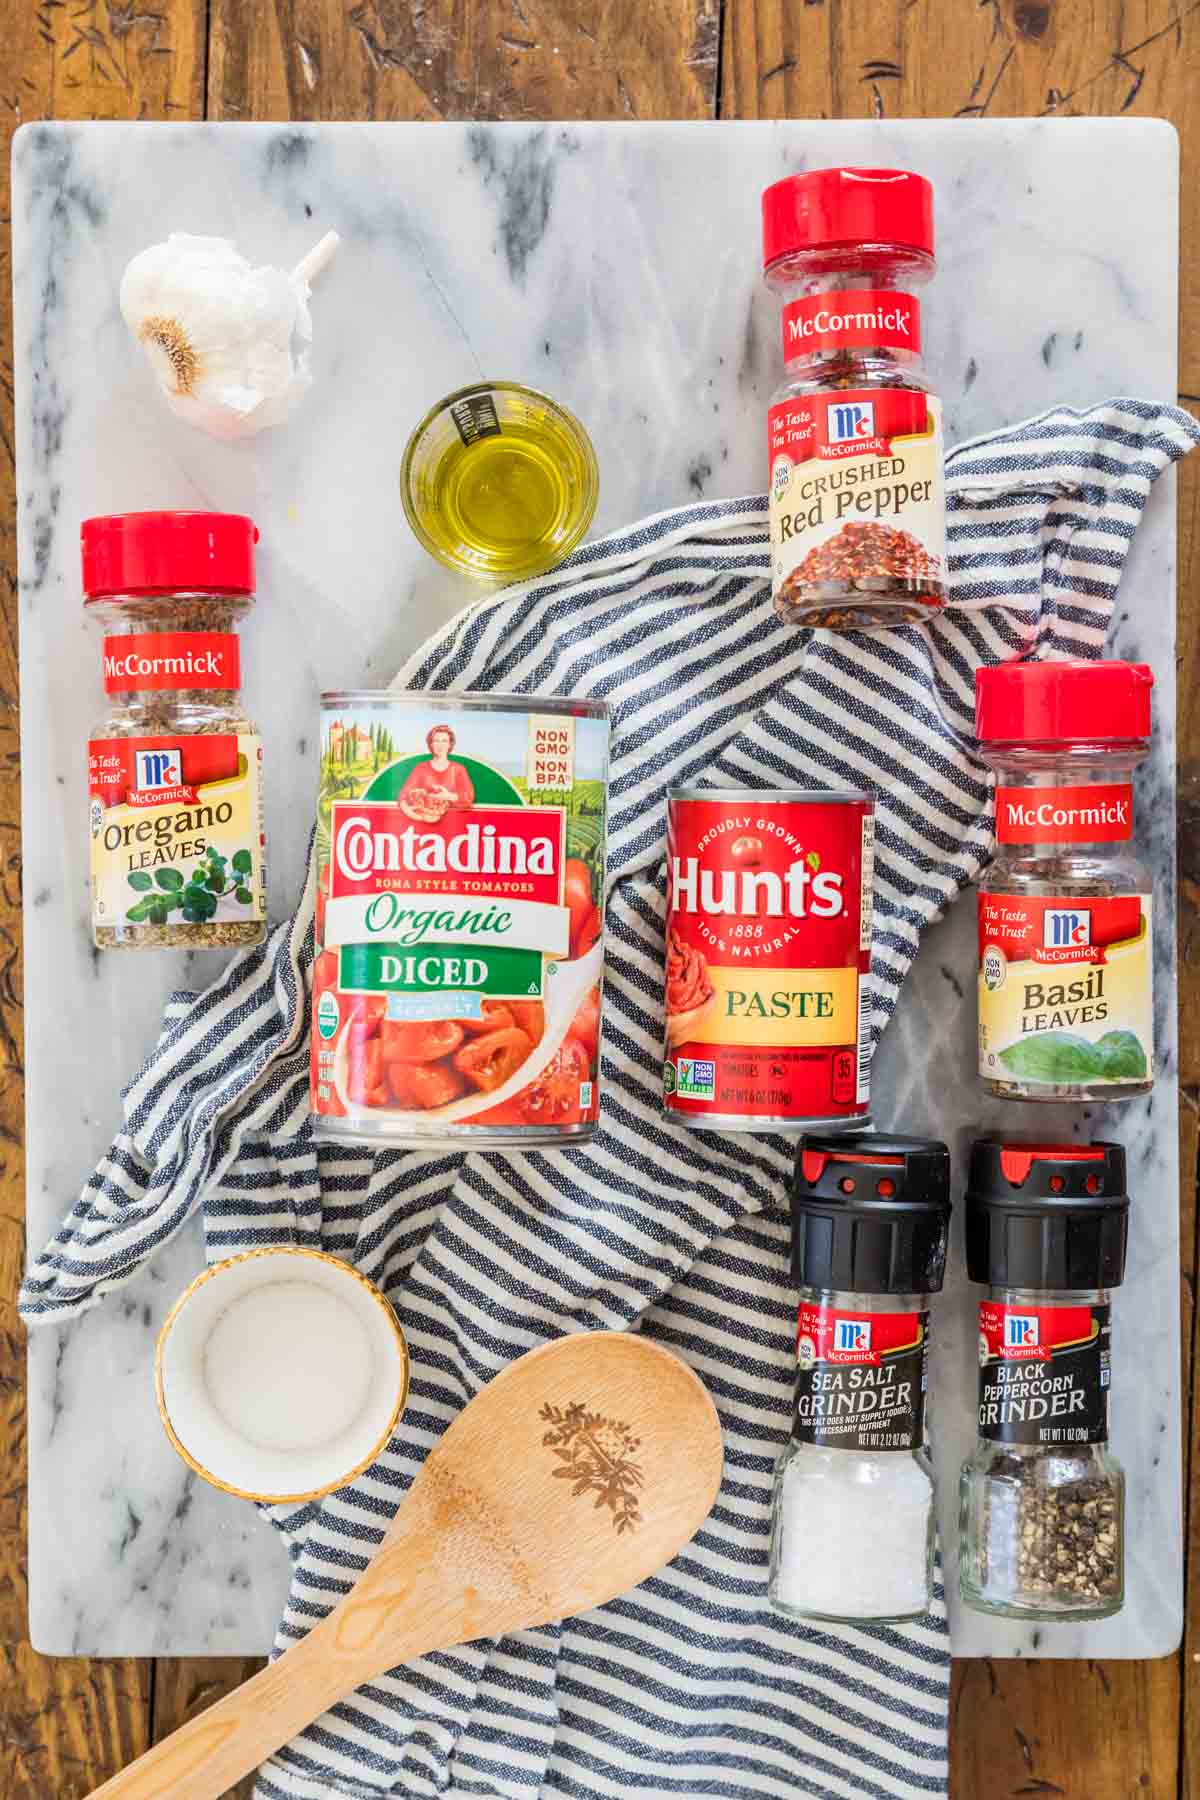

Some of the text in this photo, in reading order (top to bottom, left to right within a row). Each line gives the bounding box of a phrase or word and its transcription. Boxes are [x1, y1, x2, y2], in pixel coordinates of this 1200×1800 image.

[785, 411, 811, 425] Taste
[801, 458, 905, 500] CRUSHED
[780, 479, 932, 544] Red Pepper
[535, 730, 569, 742] NON
[535, 743, 569, 755] GMO
[535, 760, 568, 773] NON
[535, 773, 567, 785] BPA
[104, 801, 233, 852] Oregano
[698, 816, 804, 854] PROUDLY GROWN
[128, 838, 206, 872] LEAVES
[336, 816, 555, 881] Contadina
[375, 877, 535, 893] ROMA STYLE TOMATOES
[364, 892, 513, 945] Organic
[985, 906, 1027, 922] The Taste
[698, 921, 800, 957] 100% NATURAL
[728, 924, 763, 938] 1888
[985, 923, 998, 936] You
[378, 955, 489, 986] DICED
[985, 968, 1000, 978] GMO
[986, 959, 1000, 968] NON
[1023, 969, 1105, 1011] Basil
[725, 990, 834, 1019] PASTE
[1021, 1002, 1108, 1033] LEAVES
[695, 1063, 712, 1071] NON
[811, 1365, 897, 1391] SEA SALT
[997, 1363, 1045, 1383] BLACK
[984, 1374, 1074, 1401] PEPPERCORN
[799, 1382, 912, 1417] GRINDER
[979, 1390, 1085, 1425] GRINDER
[820, 1424, 857, 1434] NECESSARY
[858, 1419, 891, 1432] NUTRIENT
[827, 1416, 843, 1425] DOES
[845, 1414, 861, 1424] NOT
[860, 1410, 886, 1422] SUPPLY
[858, 1433, 869, 1446] NET
[870, 1433, 880, 1446] WT
[1039, 1428, 1050, 1441] NET
[1052, 1428, 1061, 1441] WT
[1067, 1428, 1075, 1440] OZ
